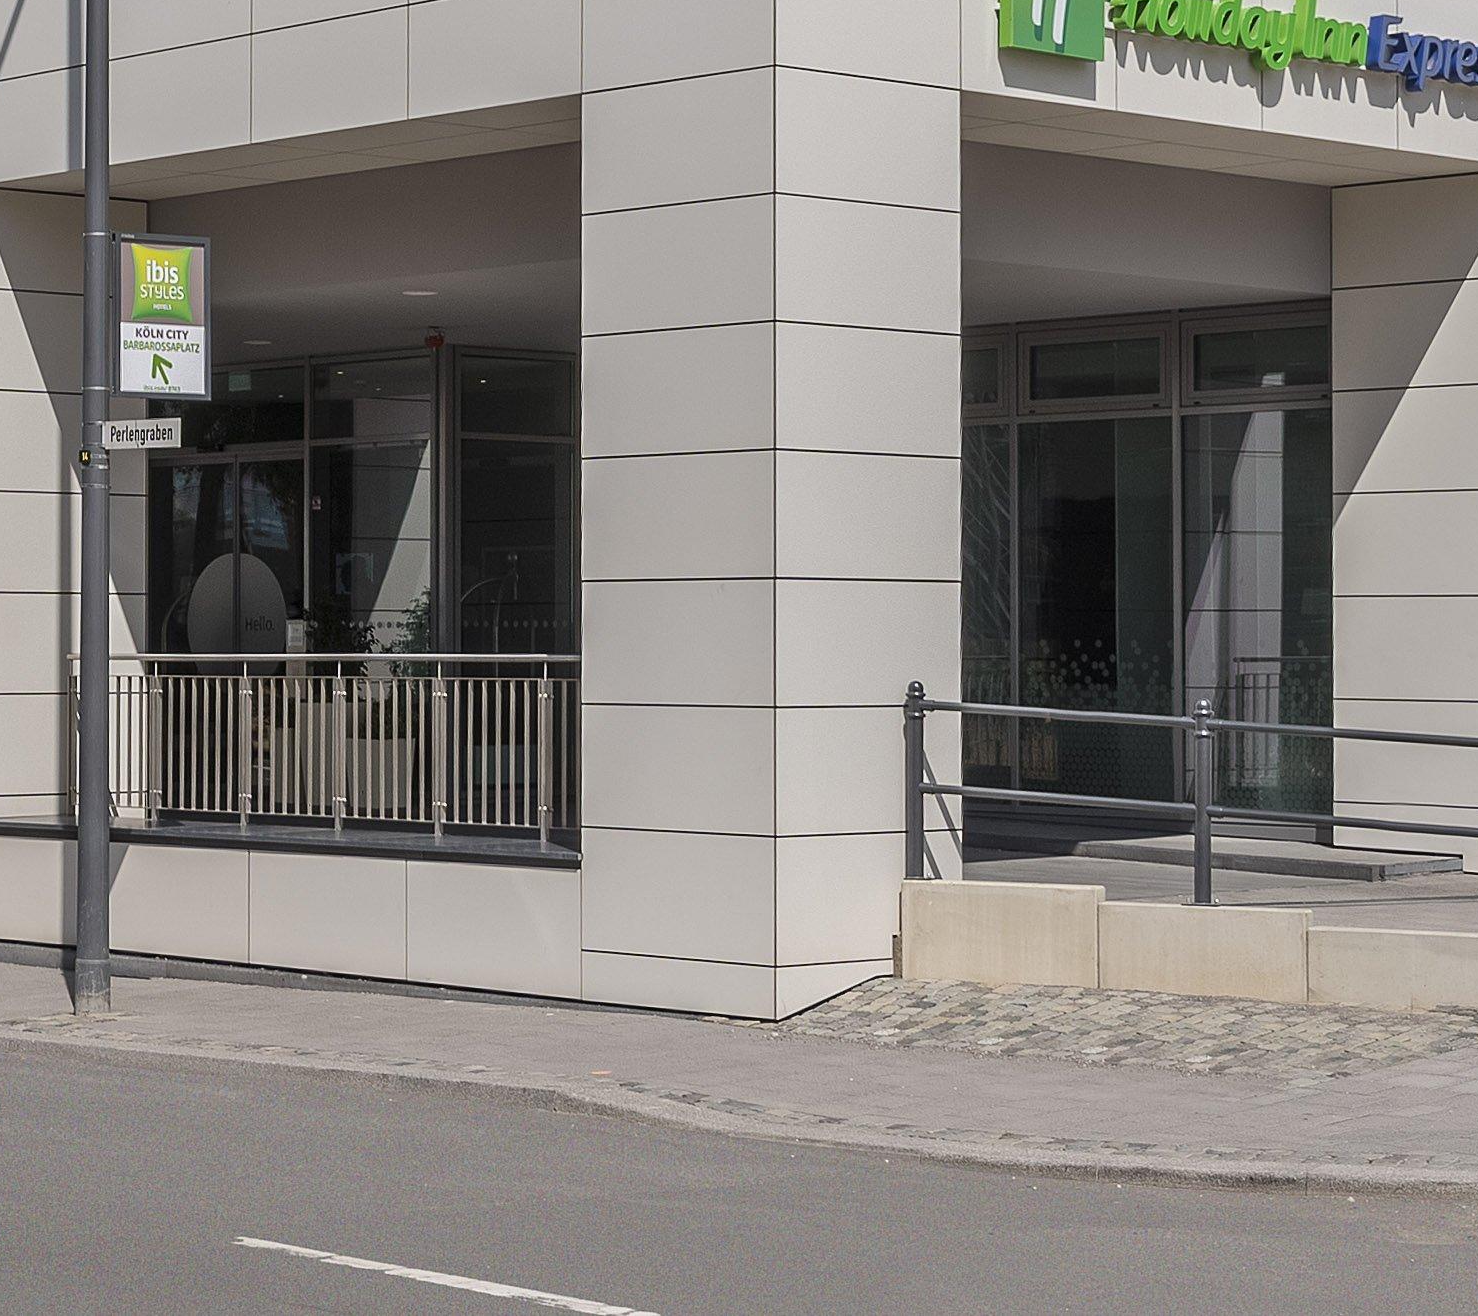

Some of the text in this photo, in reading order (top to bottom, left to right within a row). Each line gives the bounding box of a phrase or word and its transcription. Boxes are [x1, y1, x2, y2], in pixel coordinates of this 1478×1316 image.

[146, 259, 179, 284] ibis
[135, 326, 189, 340] KÖLN CITY
[123, 340, 200, 353] BARBAROSSAPLATZ
[110, 424, 173, 445] Perlengraben
[245, 615, 275, 632] Hello.
